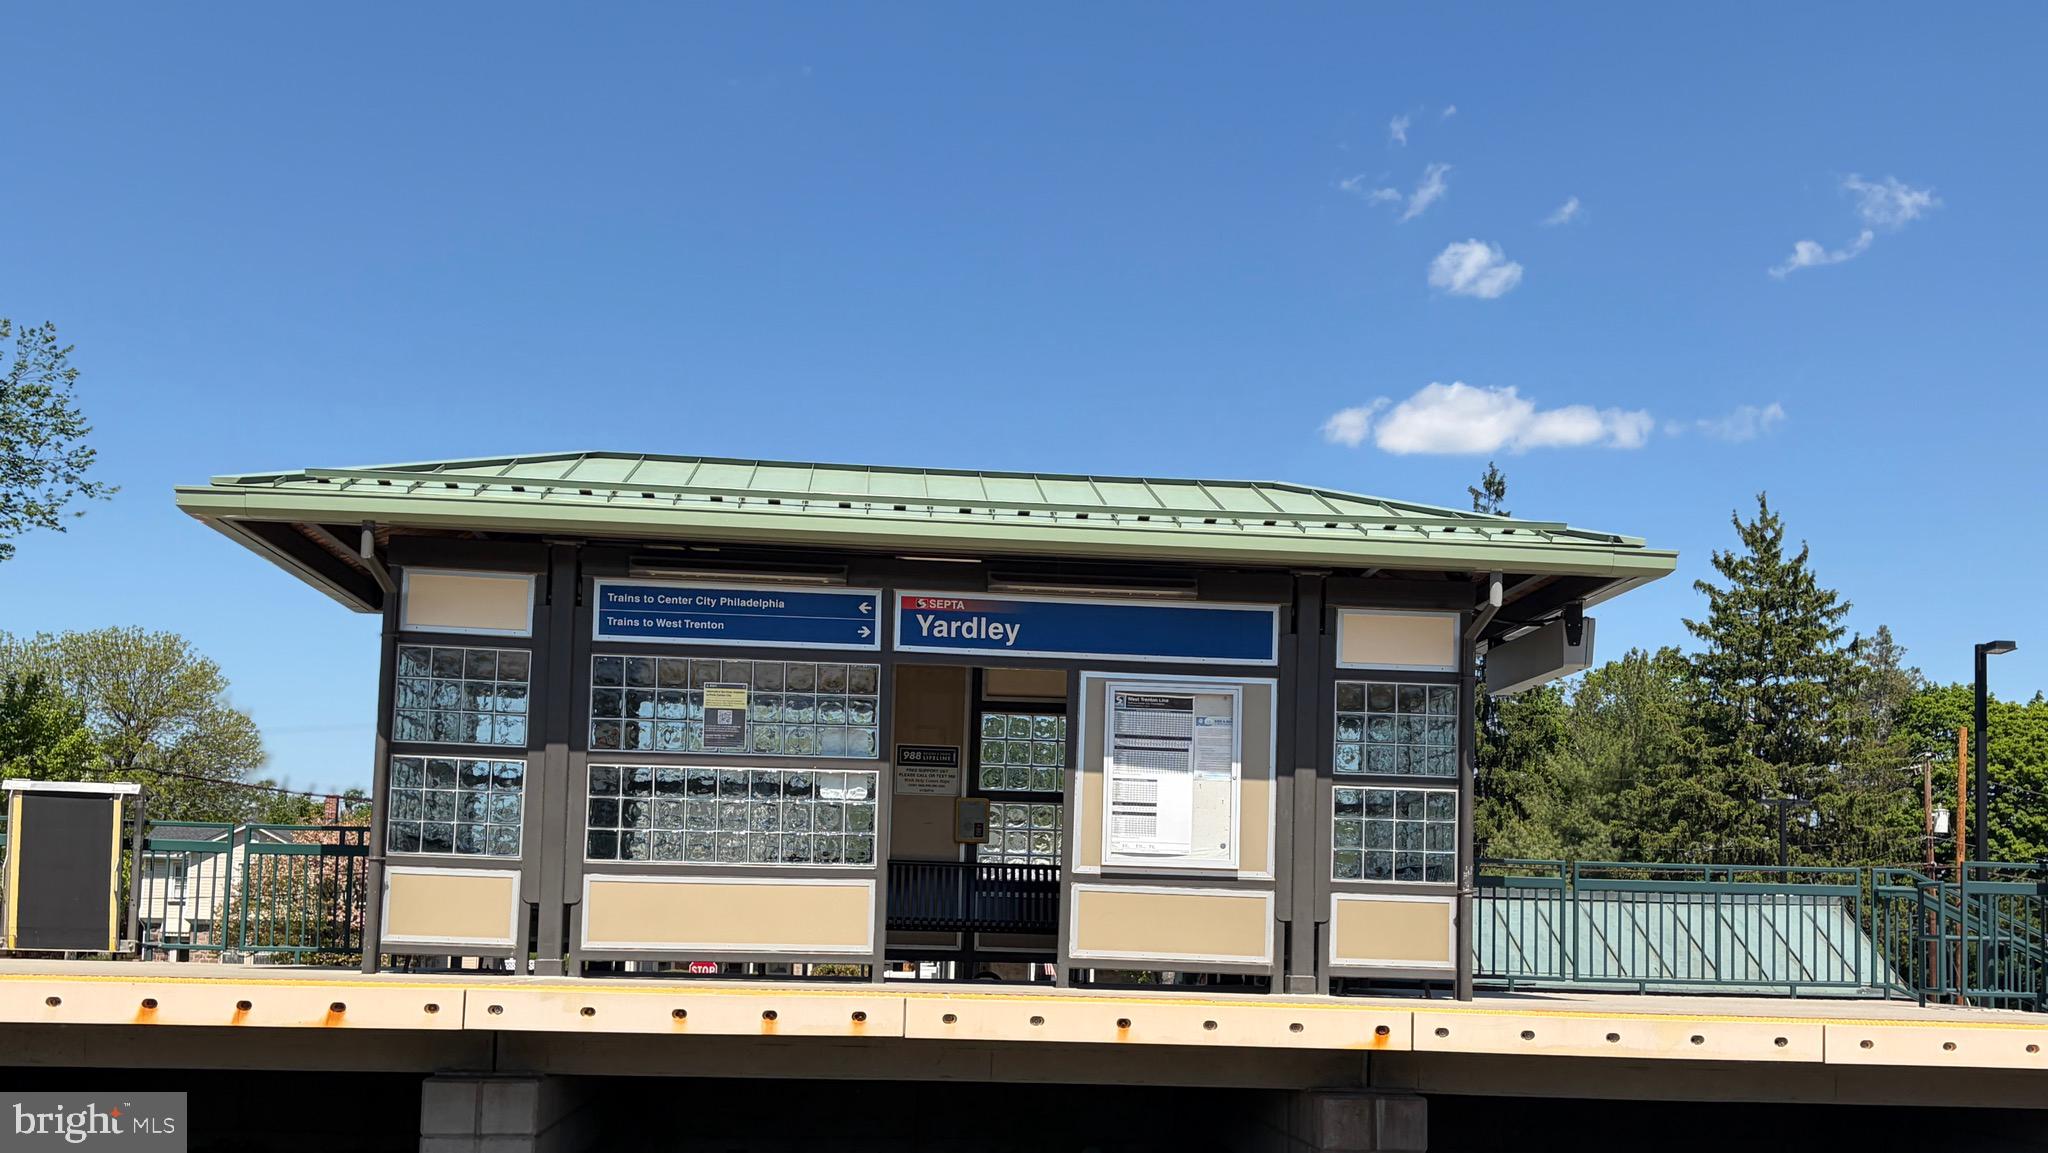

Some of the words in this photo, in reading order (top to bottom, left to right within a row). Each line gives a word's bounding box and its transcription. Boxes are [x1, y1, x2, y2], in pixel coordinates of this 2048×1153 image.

[608, 593, 640, 603] Trains
[644, 594, 654, 604] to
[657, 595, 692, 605] Center
[696, 596, 717, 608] City
[720, 597, 785, 610] Philadelphia
[929, 599, 965, 610] SEPTA
[607, 617, 640, 627] Trains
[643, 618, 653, 627] to
[656, 619, 682, 628] West
[684, 620, 724, 630] Trenton
[916, 614, 1020, 646] Yardley
[903, 751, 921, 760] 988
[691, 965, 716, 974] STOP
